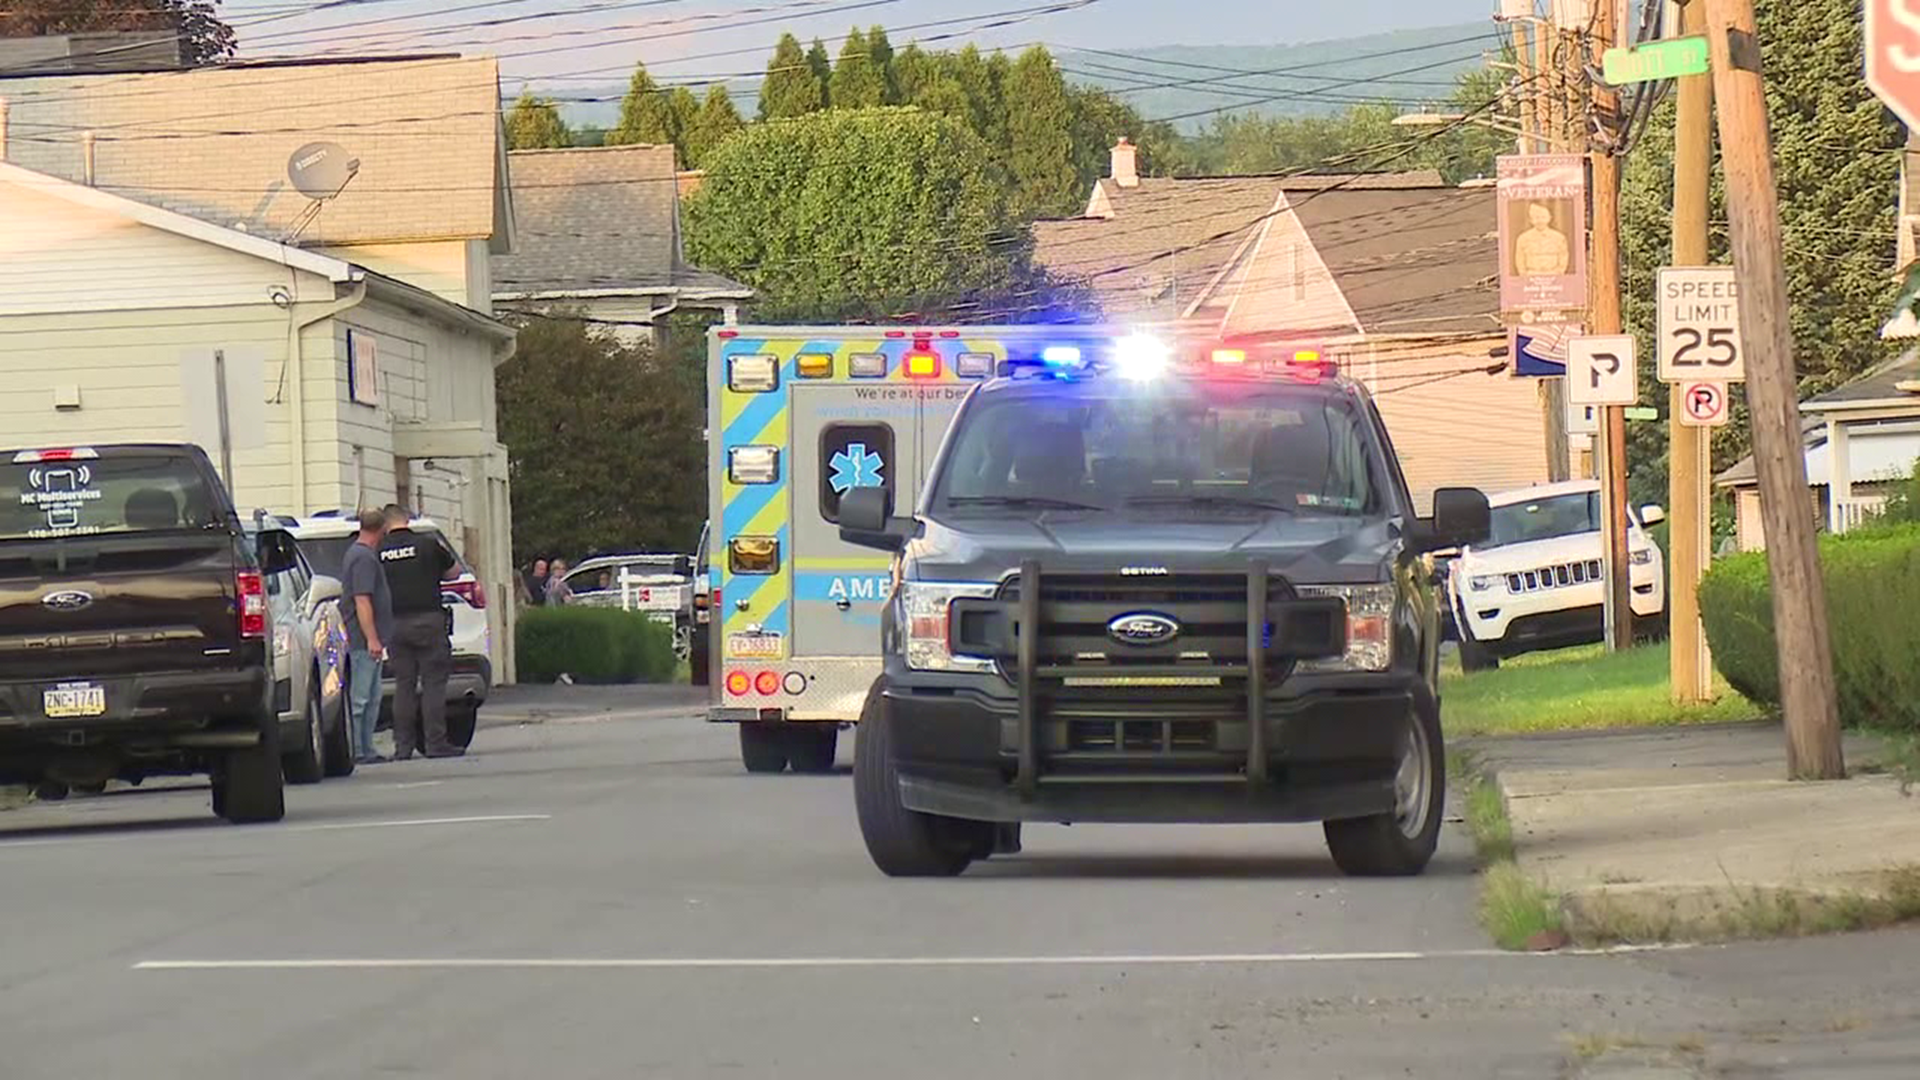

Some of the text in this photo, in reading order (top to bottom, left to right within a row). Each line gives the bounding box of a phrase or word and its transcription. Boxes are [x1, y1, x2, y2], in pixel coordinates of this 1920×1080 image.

[1507, 187, 1574, 198] VETERAN
[1675, 305, 1732, 321] LIMIT
[1672, 327, 1737, 367] 25
[856, 388, 896, 398] We're
[899, 389, 912, 398] at
[918, 388, 940, 398] our
[37, 488, 101, 502] Multiservices
[380, 546, 415, 561] POLICE
